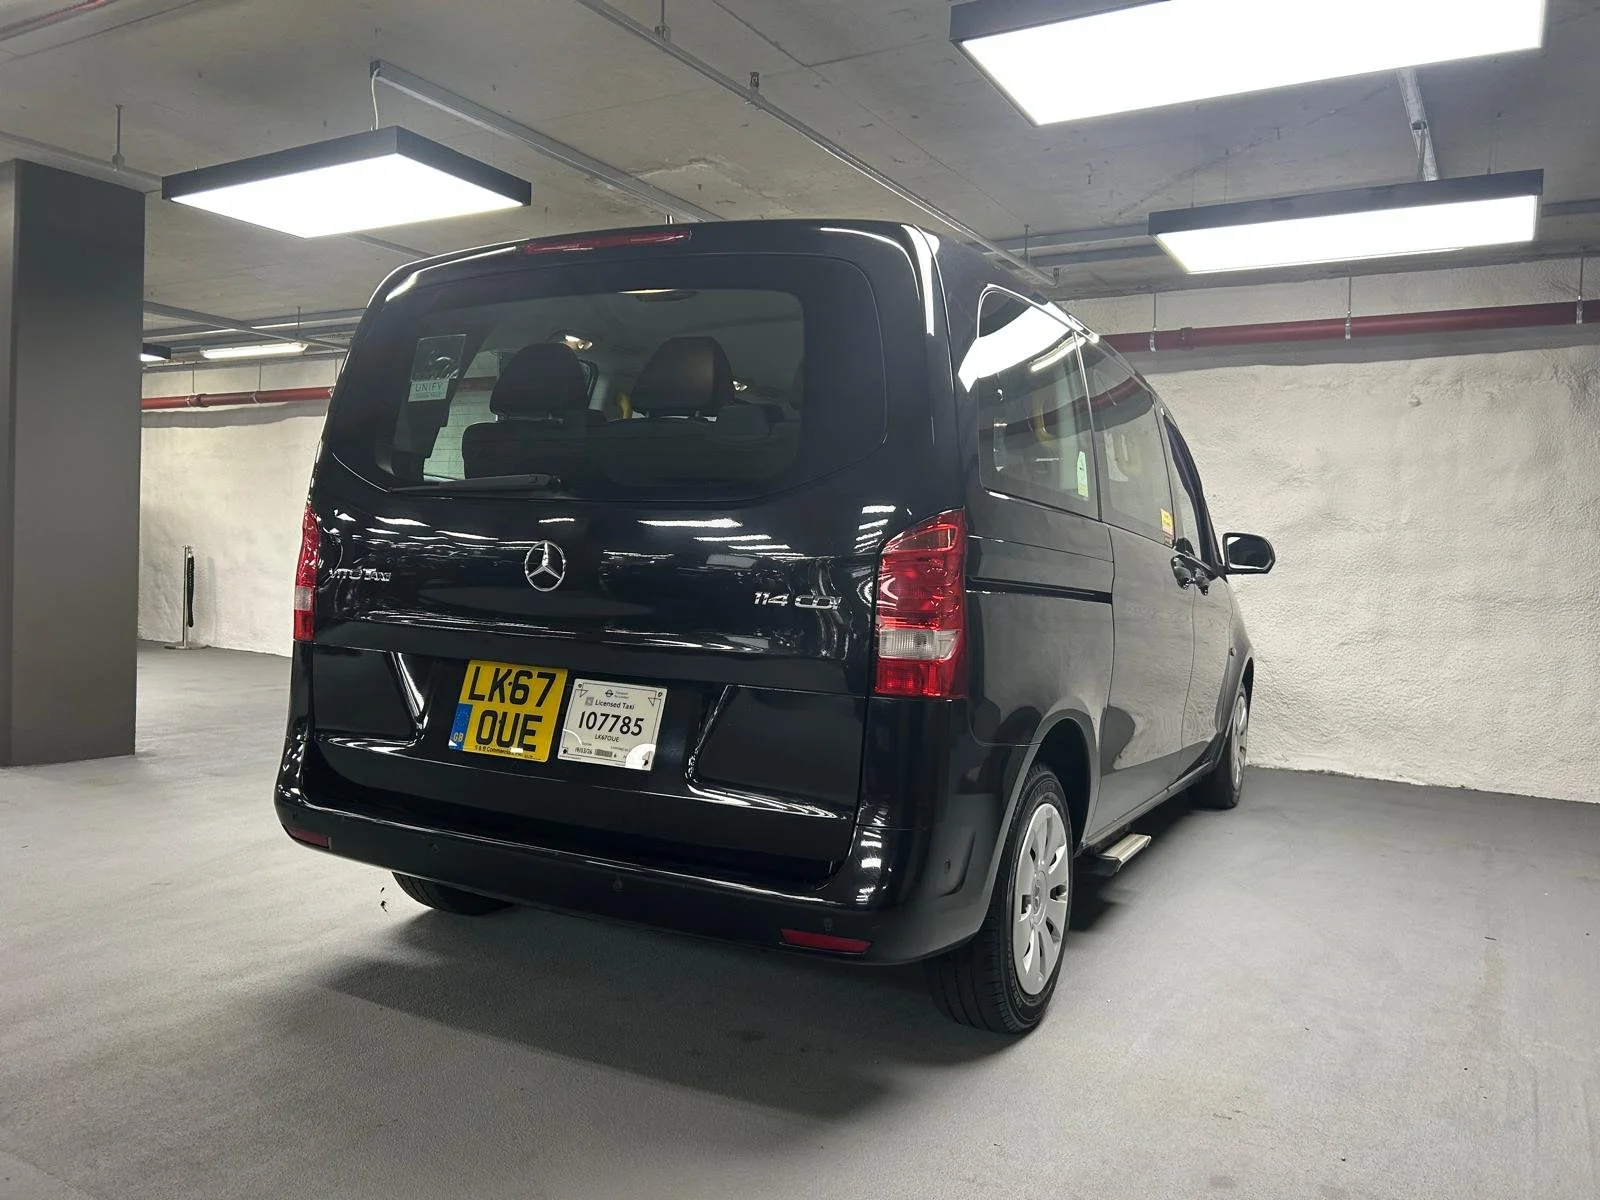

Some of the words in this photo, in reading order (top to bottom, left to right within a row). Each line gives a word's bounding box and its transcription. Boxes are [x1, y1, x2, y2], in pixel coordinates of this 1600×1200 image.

[415, 382, 444, 393] UNIFY
[754, 591, 789, 606] 114
[795, 595, 842, 610] CDI
[468, 665, 557, 708] LK67
[595, 700, 621, 709] Licensed
[622, 702, 635, 710] Taxi
[475, 709, 543, 753] OUE
[578, 711, 645, 737] 107785
[453, 731, 464, 743] GB
